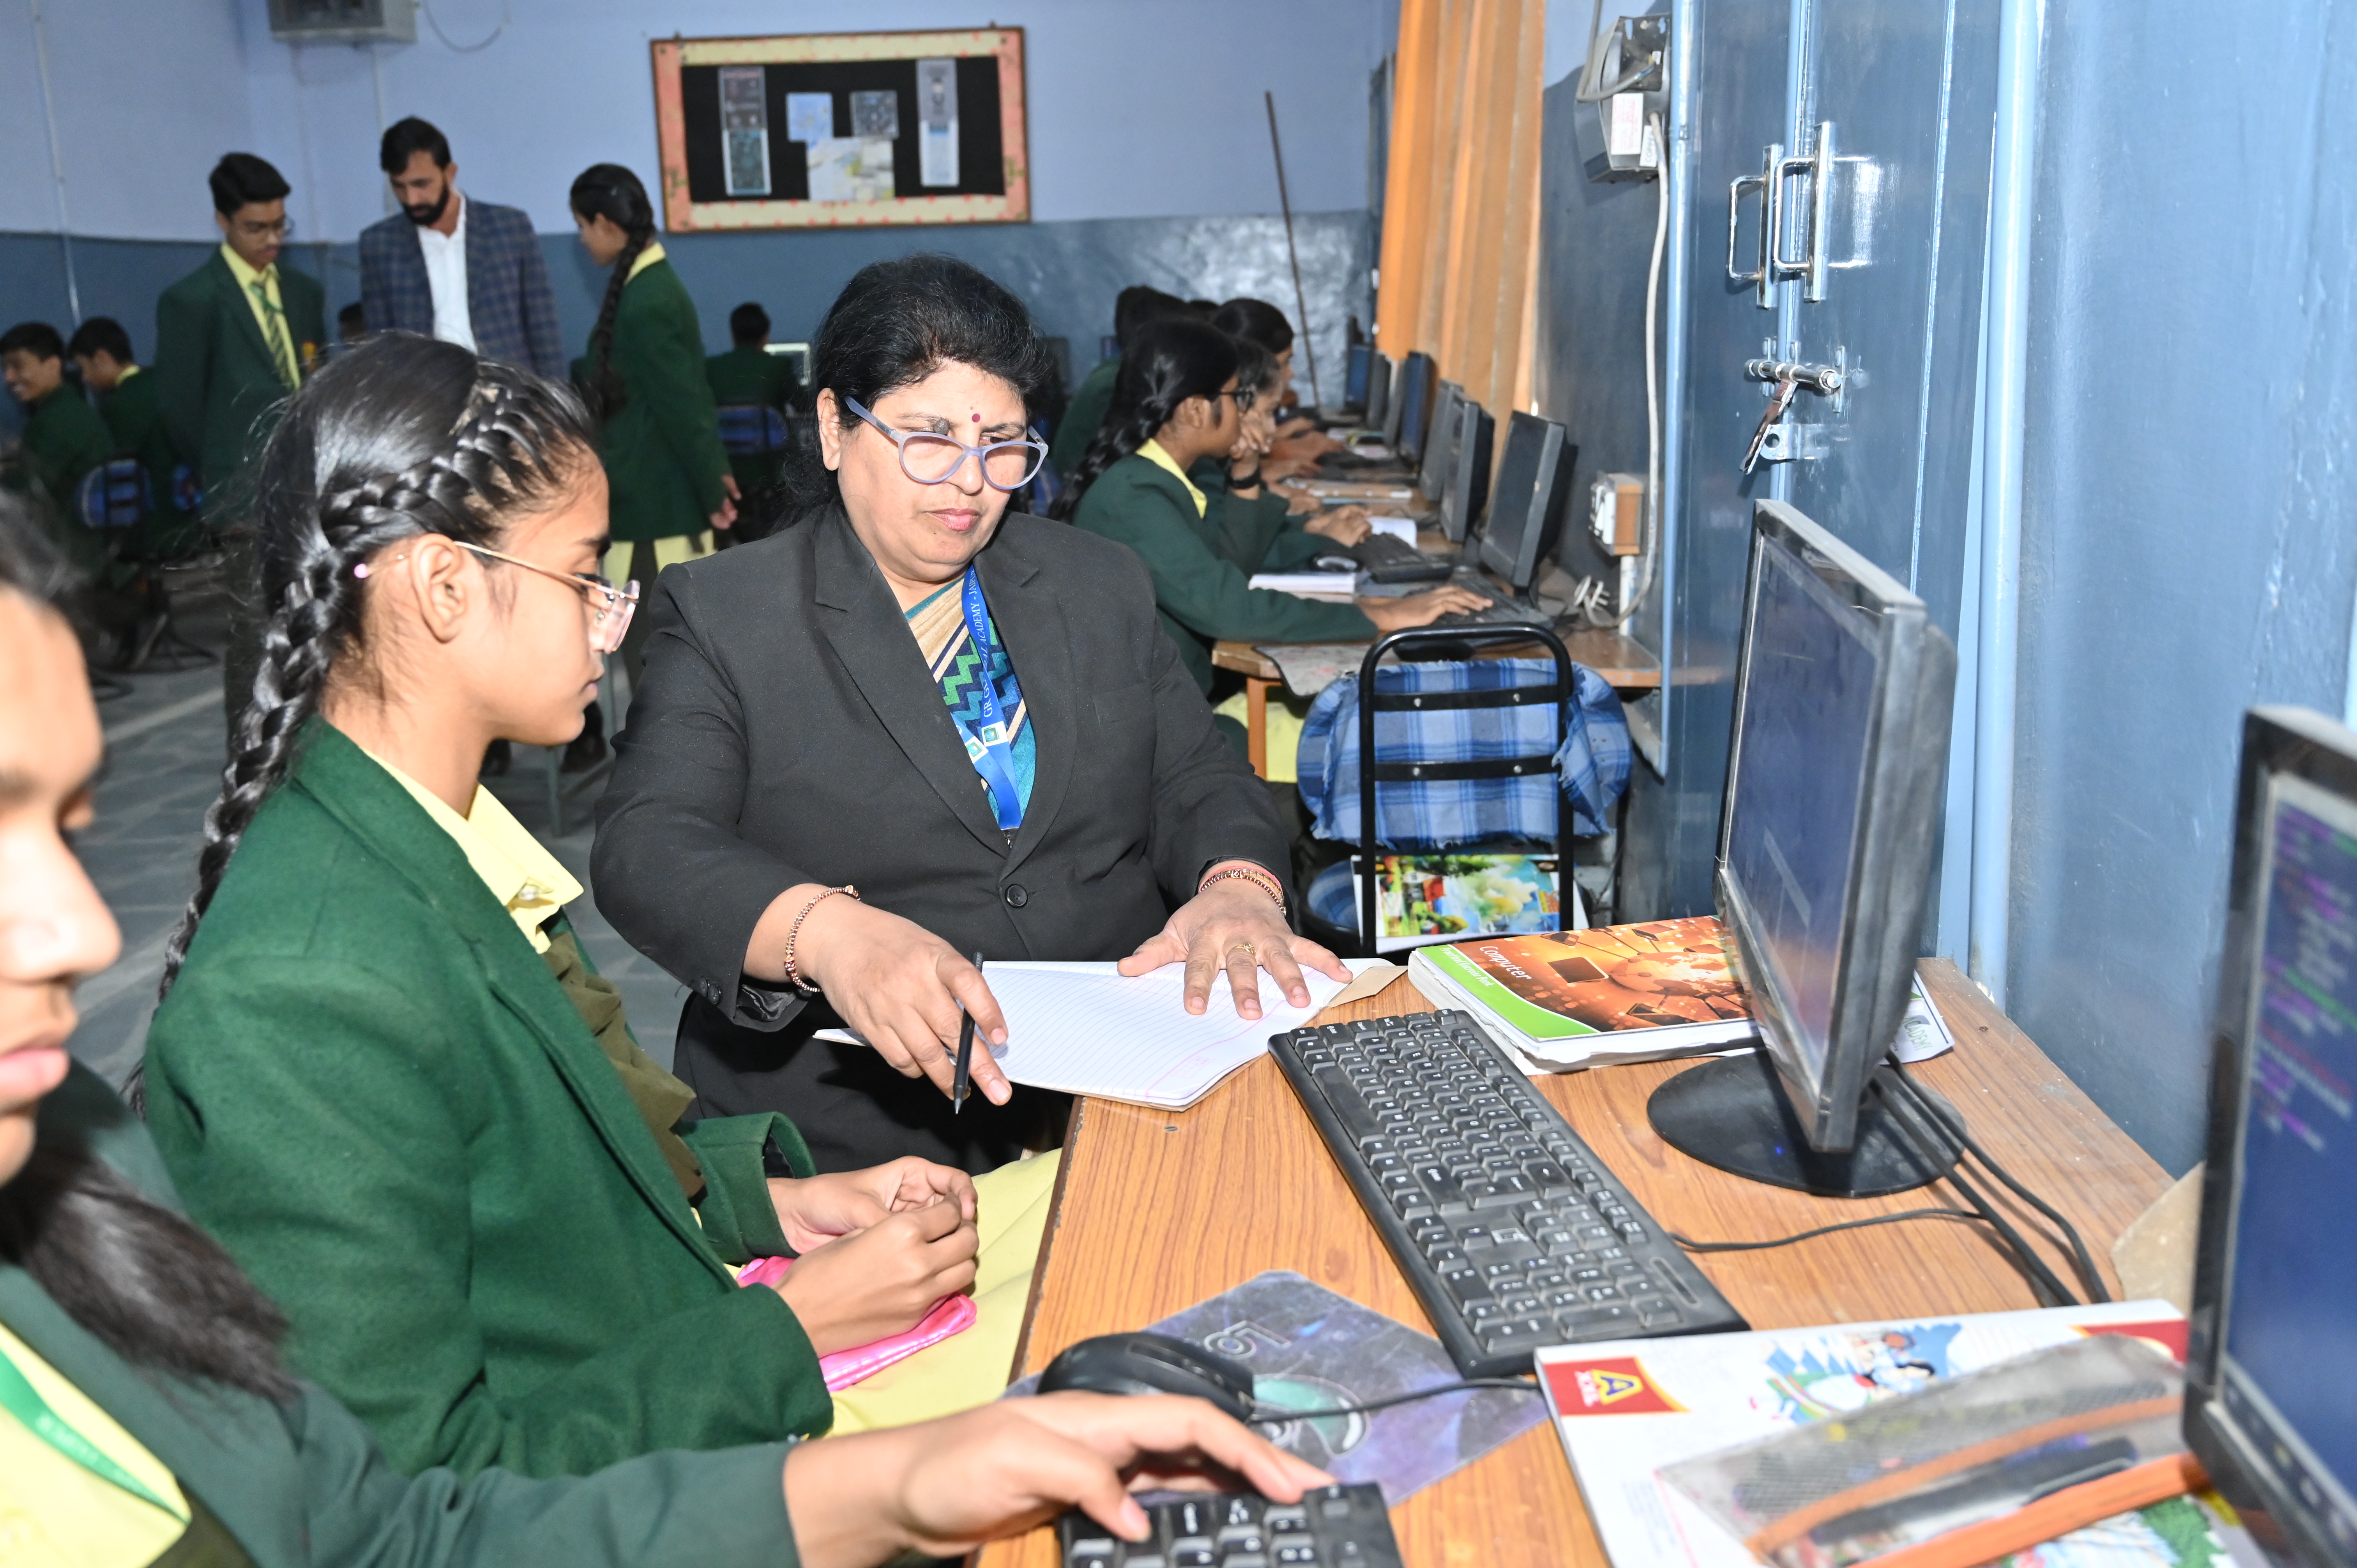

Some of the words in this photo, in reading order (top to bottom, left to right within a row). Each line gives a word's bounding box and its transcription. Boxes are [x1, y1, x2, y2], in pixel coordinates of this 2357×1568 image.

[969, 568, 977, 595] JAIPUR
[971, 603, 988, 645] ACADEMY
[984, 697, 993, 717] GR
[1439, 948, 1461, 963] Practical
[1459, 961, 1481, 977] Exercise
[1476, 976, 1495, 987] Book
[1480, 946, 1532, 980] Computer
